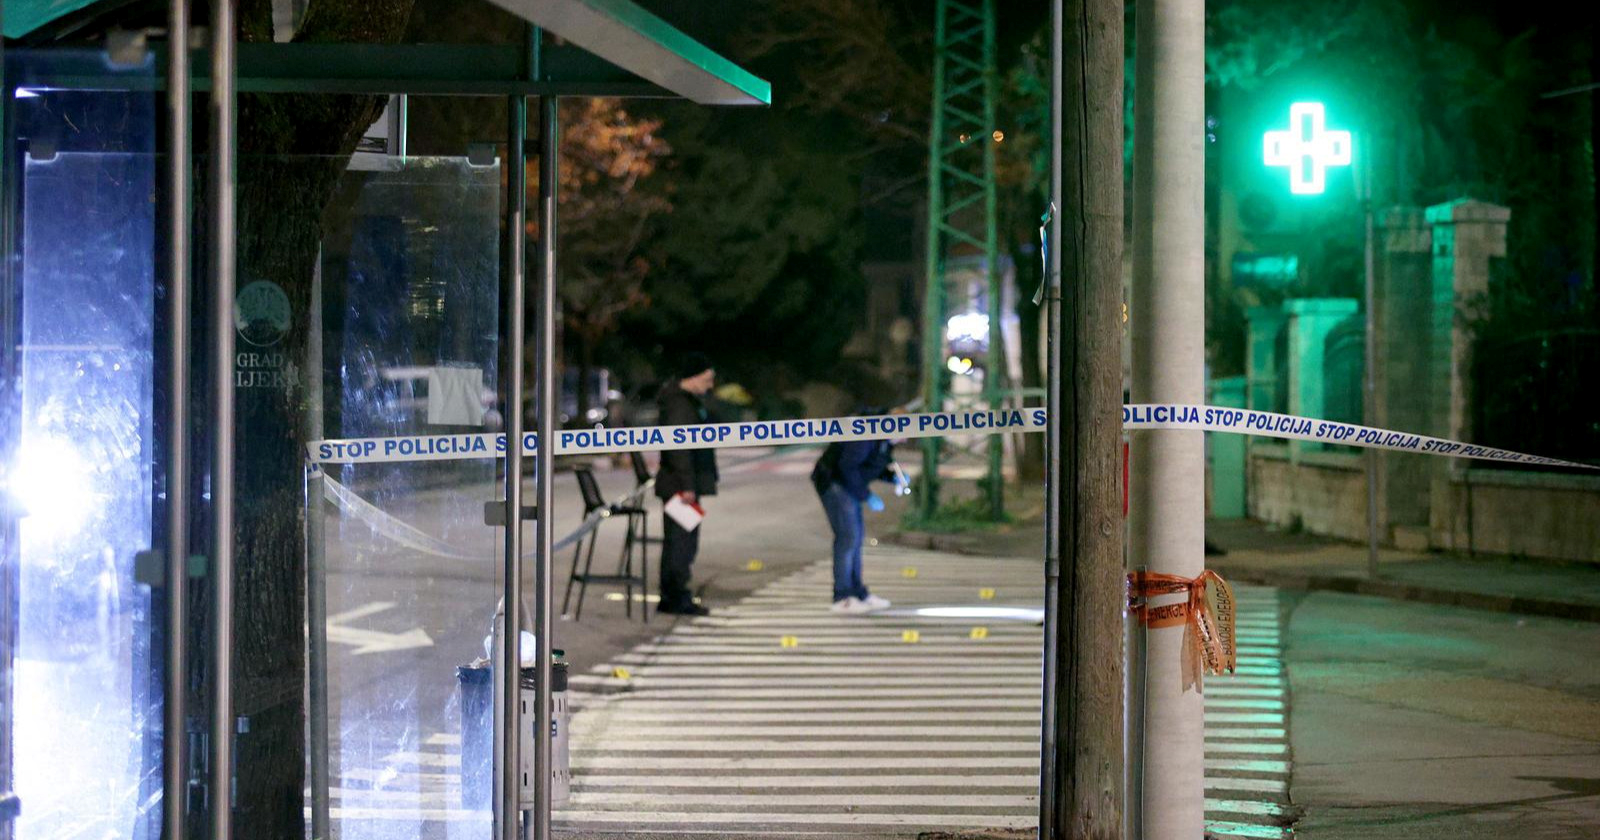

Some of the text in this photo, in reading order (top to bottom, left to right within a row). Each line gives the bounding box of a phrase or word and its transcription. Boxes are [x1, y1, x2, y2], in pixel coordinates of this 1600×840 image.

[236, 352, 284, 368] GRAD
[319, 442, 377, 459] STOP
[384, 435, 487, 456] POLICIJA
[561, 429, 665, 448] POLICIJA
[673, 426, 732, 443] STOP
[739, 420, 844, 440] POLICIJA
[852, 417, 911, 435] STOP
[918, 410, 1025, 431] POLICIJA
[1205, 409, 1244, 427] STOP
[1246, 413, 1312, 436] POLICIJA
[1315, 423, 1355, 443] STOP
[1355, 429, 1421, 450] POLICIJA
[1421, 440, 1459, 454] STOP
[1459, 446, 1523, 462] POLICIJA
